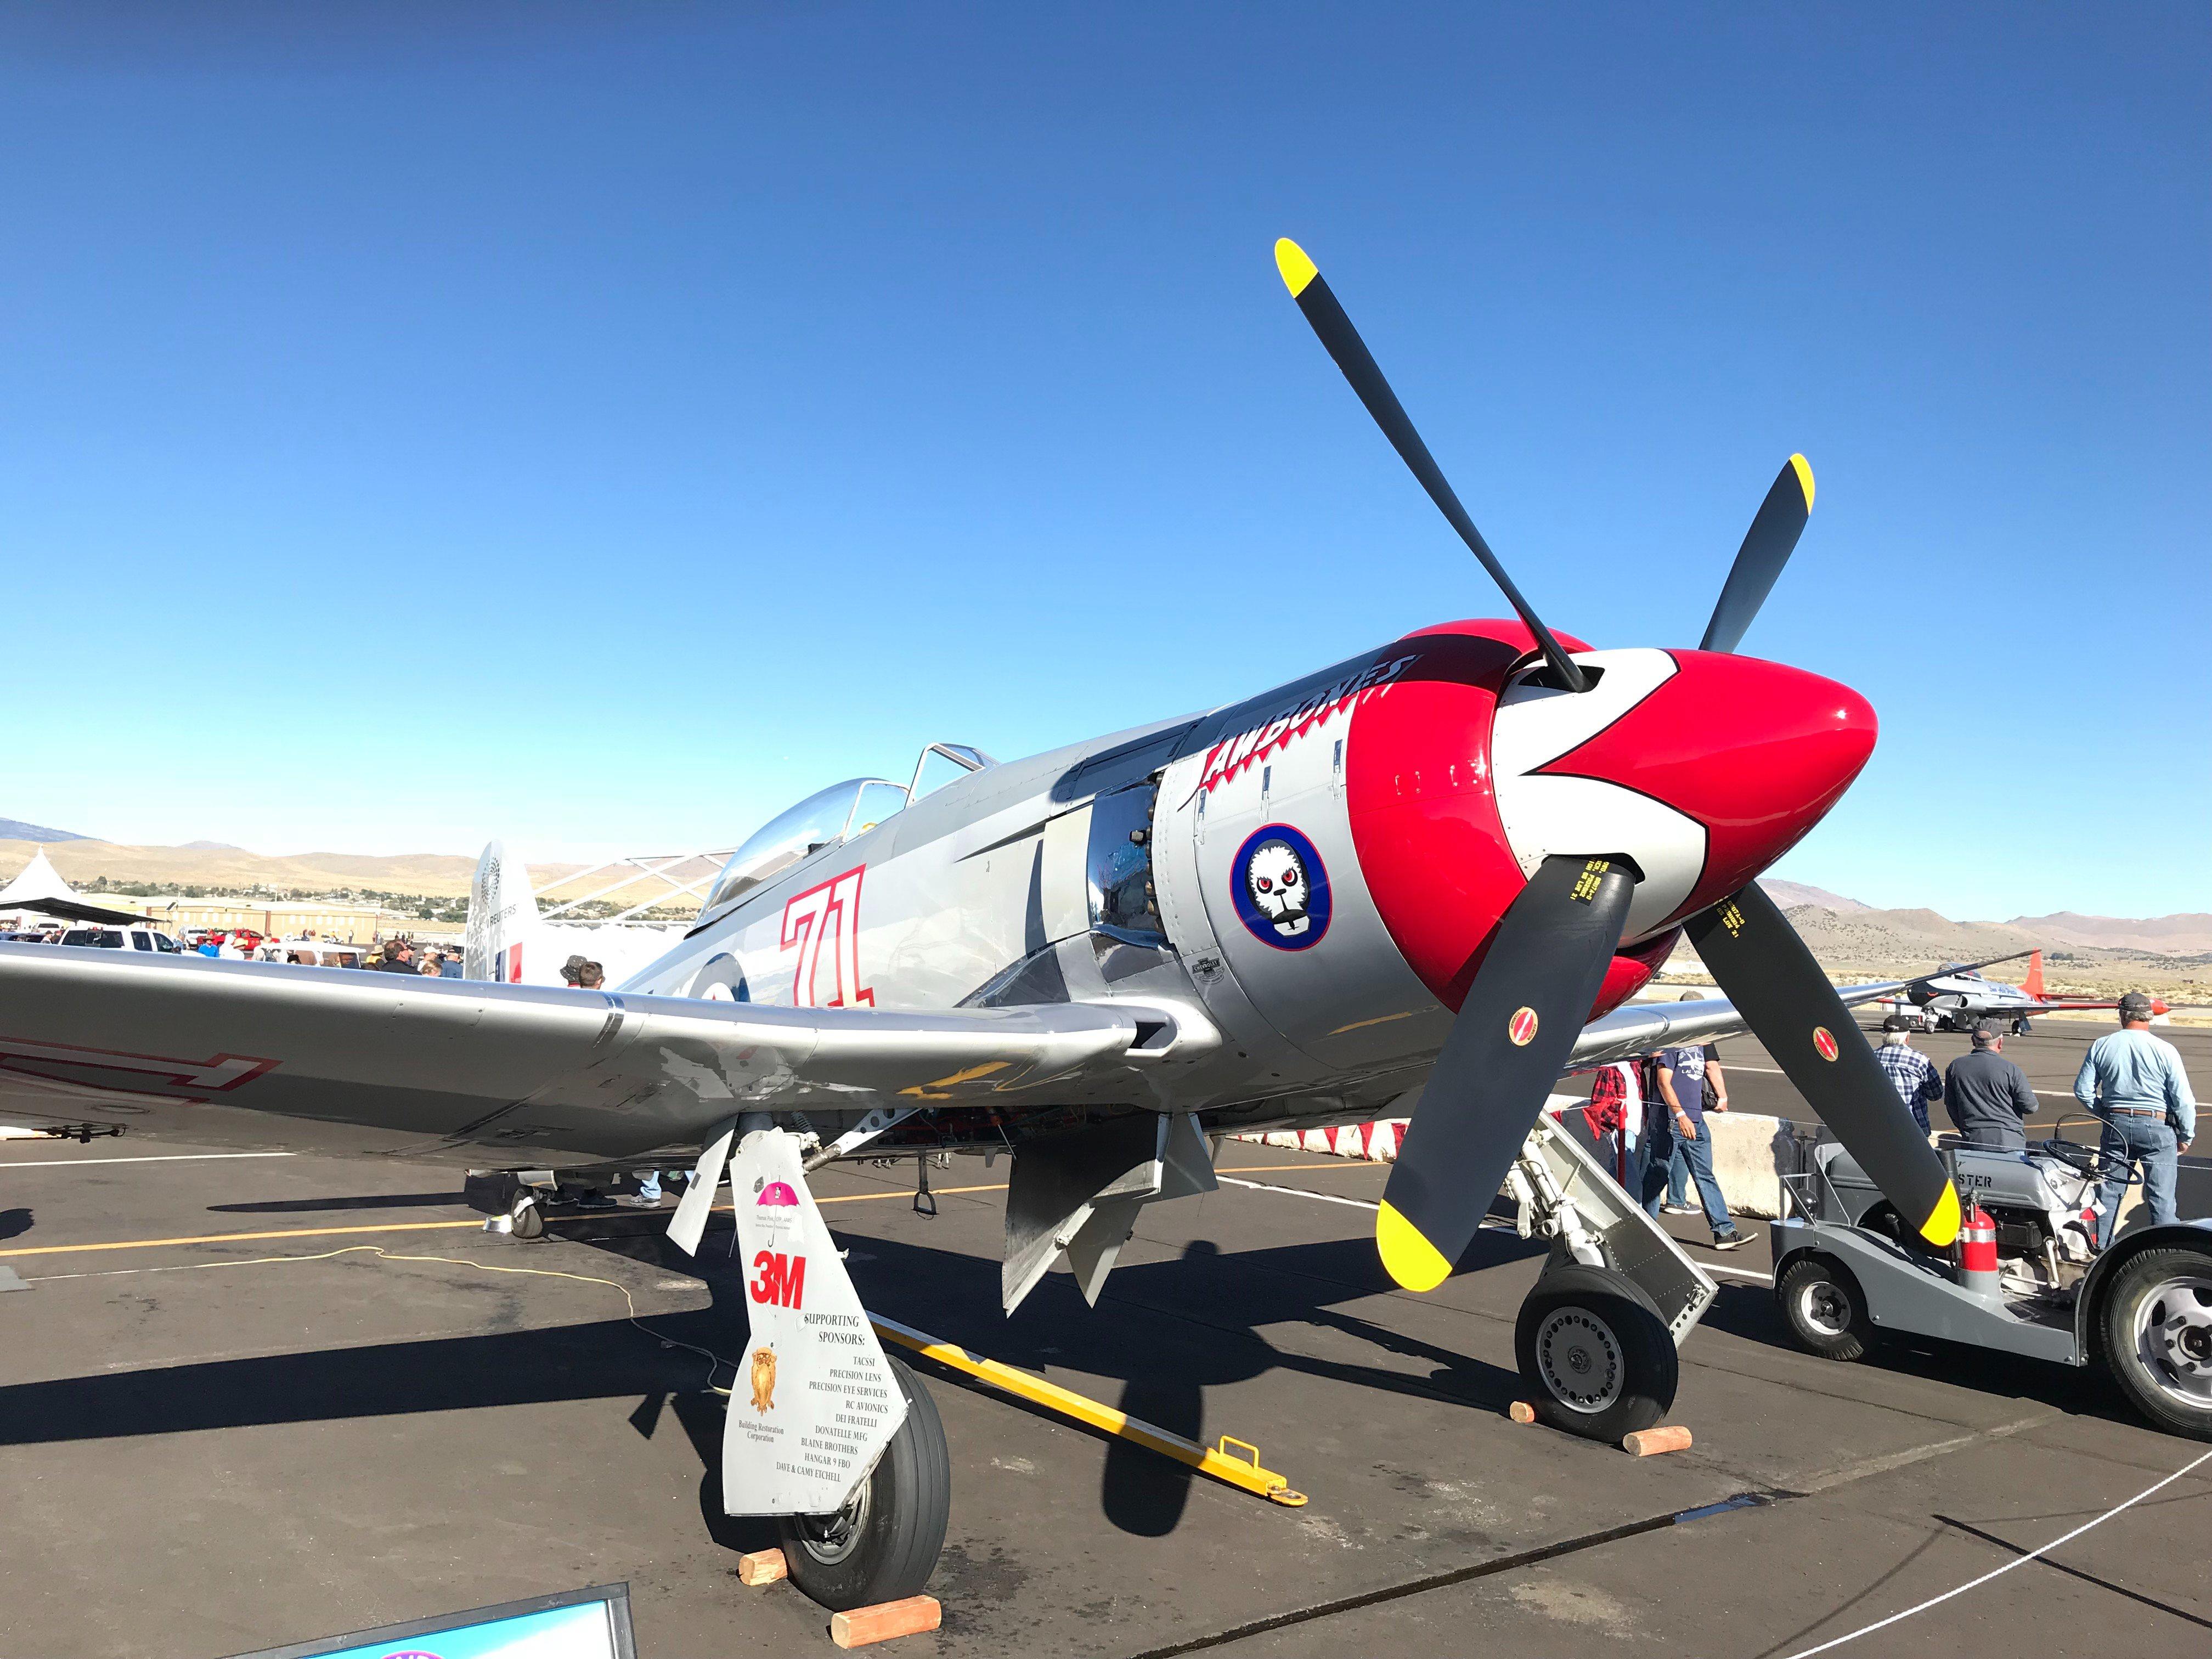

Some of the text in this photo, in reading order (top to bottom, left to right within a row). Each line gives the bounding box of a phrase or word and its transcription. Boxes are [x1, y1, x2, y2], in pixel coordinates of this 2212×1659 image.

[490, 904, 516, 927] REUTERS
[780, 863, 875, 1008] 71
[1959, 1173, 1992, 1188] STER
[751, 1250, 806, 1310] 3M
[804, 1313, 859, 1327] SUPPORTING
[819, 1331, 865, 1346] SPONSORS:
[853, 1356, 875, 1367] TACSSI
[830, 1369, 882, 1383] PRECISION LENS
[809, 1381, 888, 1398] PRECISION EYE SERVICES
[845, 1400, 888, 1414] RC AVIONICS
[738, 1419, 784, 1435] Building Restoration
[836, 1413, 877, 1427] DEI FRATELLI
[747, 1431, 774, 1443] Corporation
[815, 1425, 868, 1442] DONATELLE MFG
[801, 1437, 858, 1455] BLAINE BROTHERS
[805, 1453, 831, 1465] HANGAR
[838, 1459, 850, 1469] FBO
[776, 1462, 841, 1482] DAVE & CAMY ETCHELL
